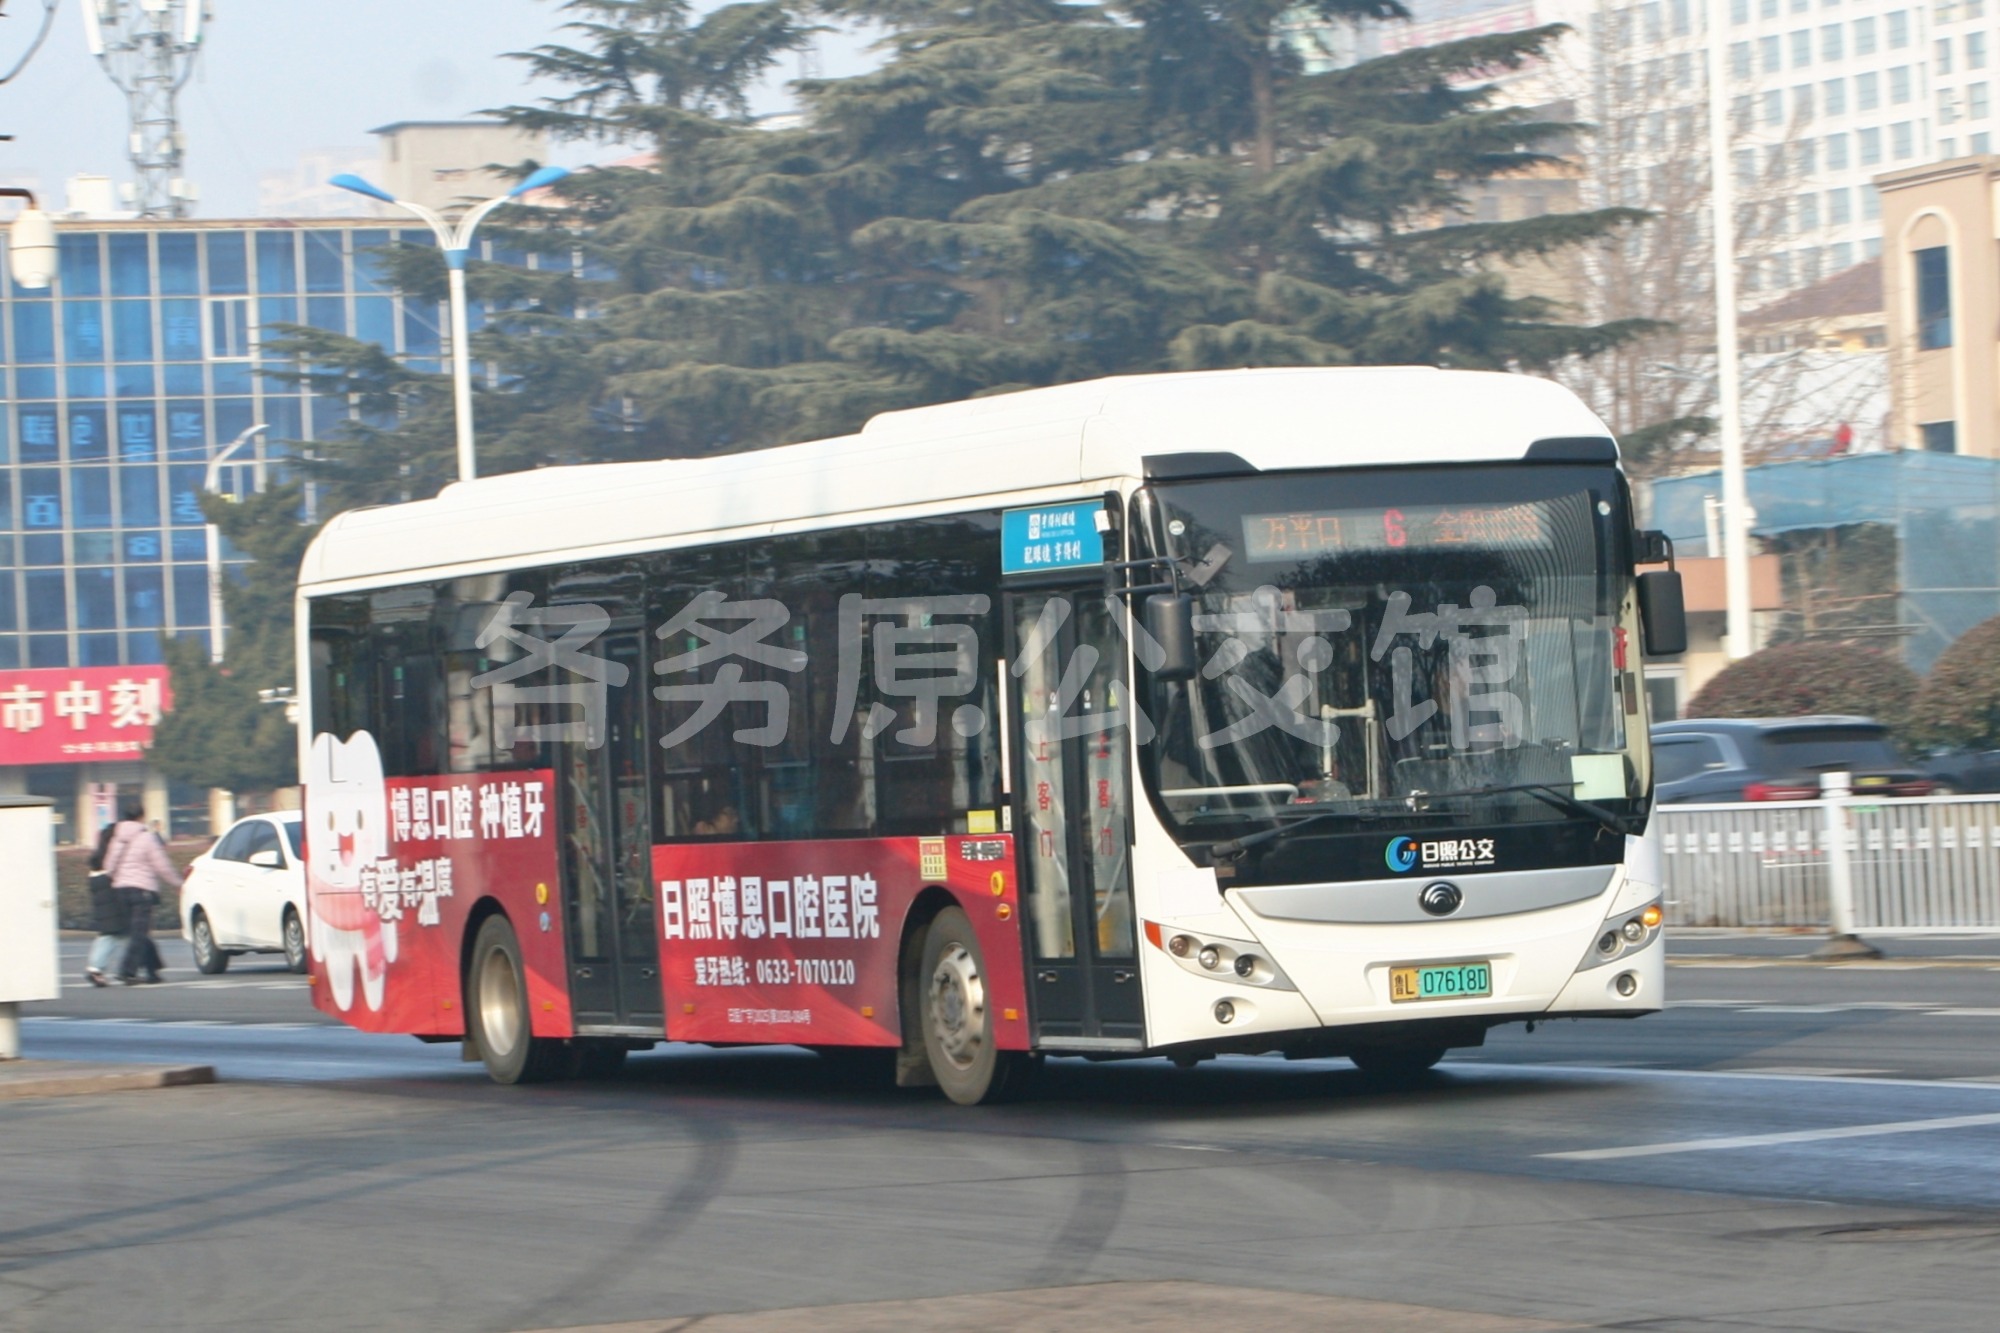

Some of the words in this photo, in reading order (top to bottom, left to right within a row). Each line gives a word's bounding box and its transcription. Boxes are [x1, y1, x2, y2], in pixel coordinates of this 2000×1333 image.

[1261, 513, 1342, 550] 万平口
[1382, 509, 1407, 547] 6
[0, 678, 162, 732] 市中刻
[390, 784, 475, 842] 博恩口腔
[479, 781, 545, 839] 种植牙
[1421, 838, 1495, 862] 日照公交
[661, 873, 880, 940] 日照博恩口腔医院
